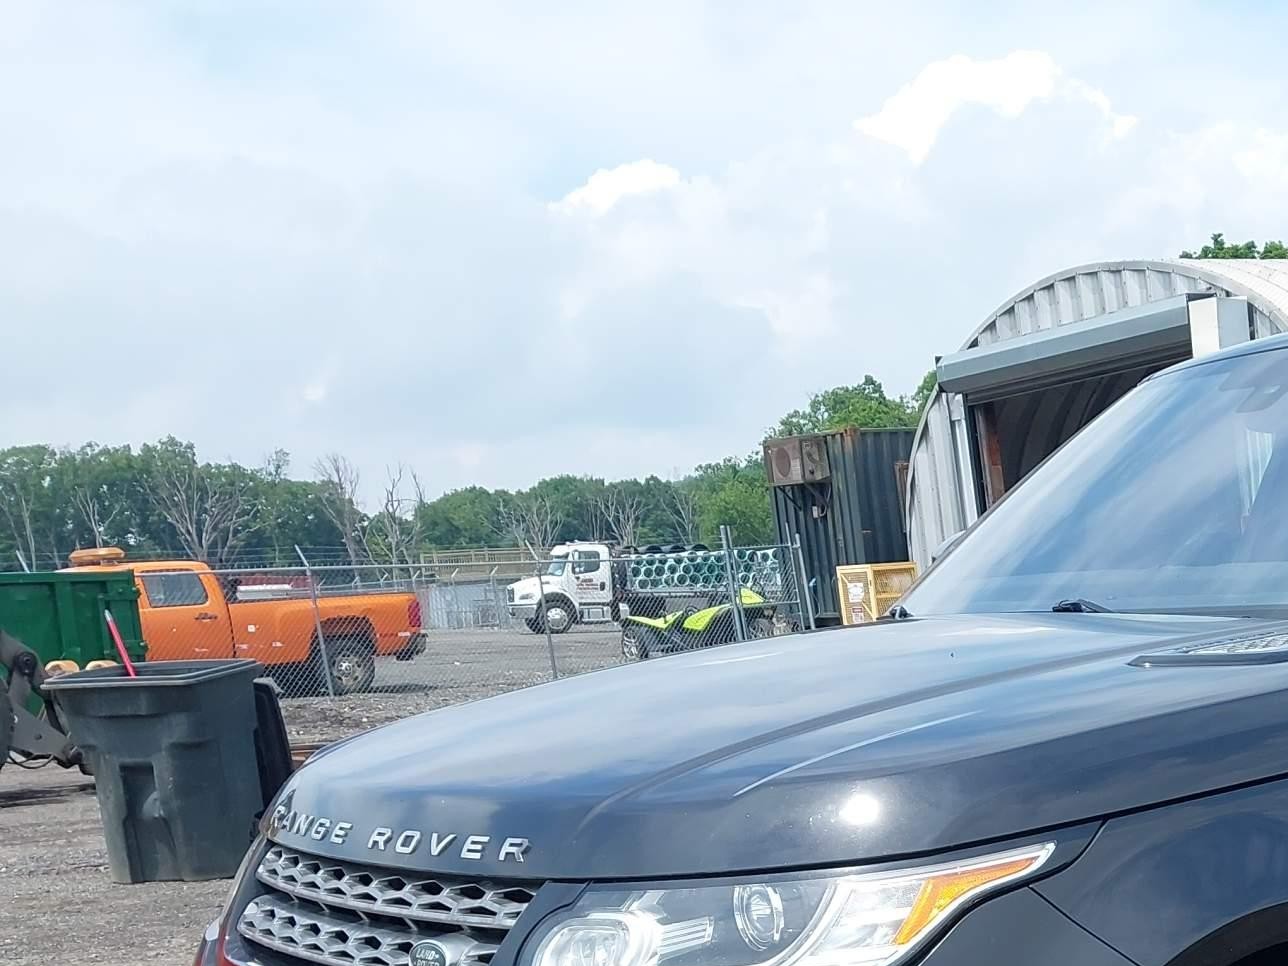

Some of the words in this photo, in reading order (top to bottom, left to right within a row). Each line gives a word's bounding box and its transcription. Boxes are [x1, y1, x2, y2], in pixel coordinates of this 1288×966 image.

[271, 805, 353, 844] RANGE
[367, 827, 530, 863] ROVER
[415, 948, 436, 961] LAND
